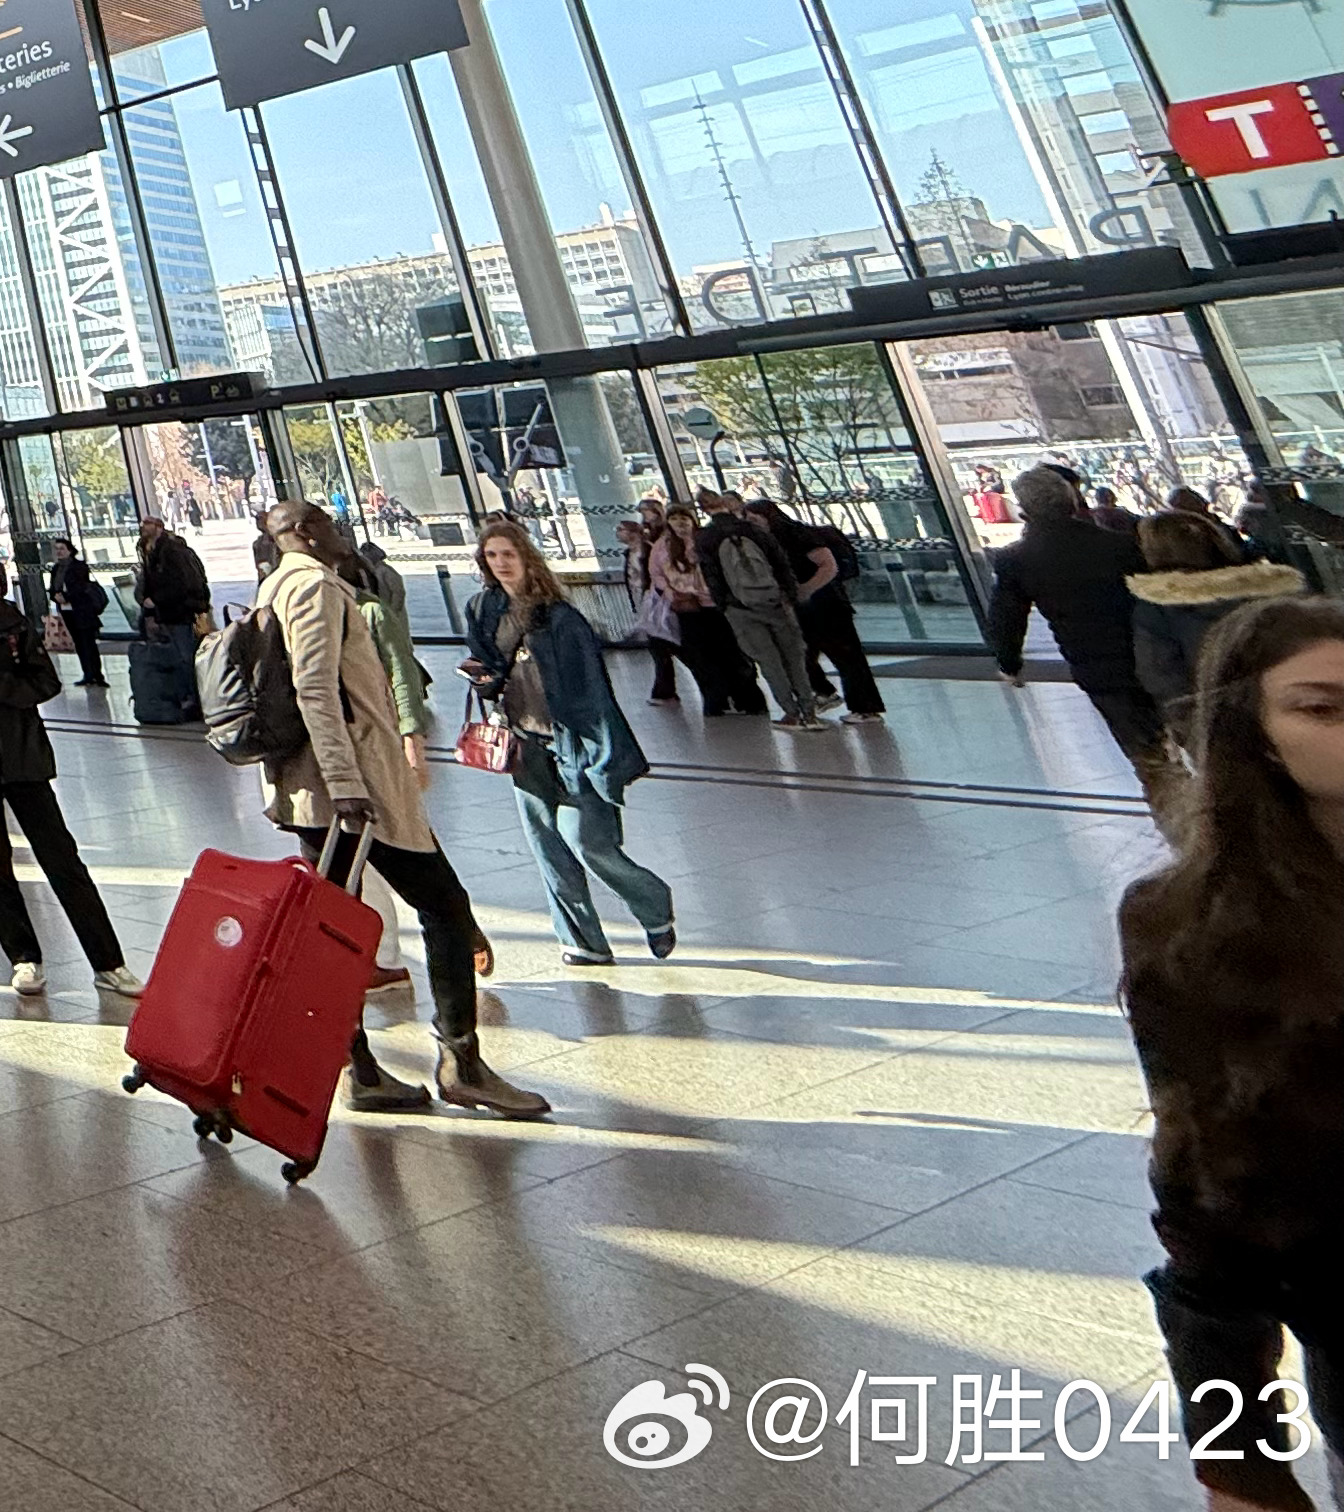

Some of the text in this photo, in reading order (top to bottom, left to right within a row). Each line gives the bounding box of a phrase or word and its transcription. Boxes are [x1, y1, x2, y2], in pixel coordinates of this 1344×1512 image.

[15, 61, 71, 89] Biglietterie
[1204, 99, 1274, 159] T
[959, 285, 999, 299] Sortie
